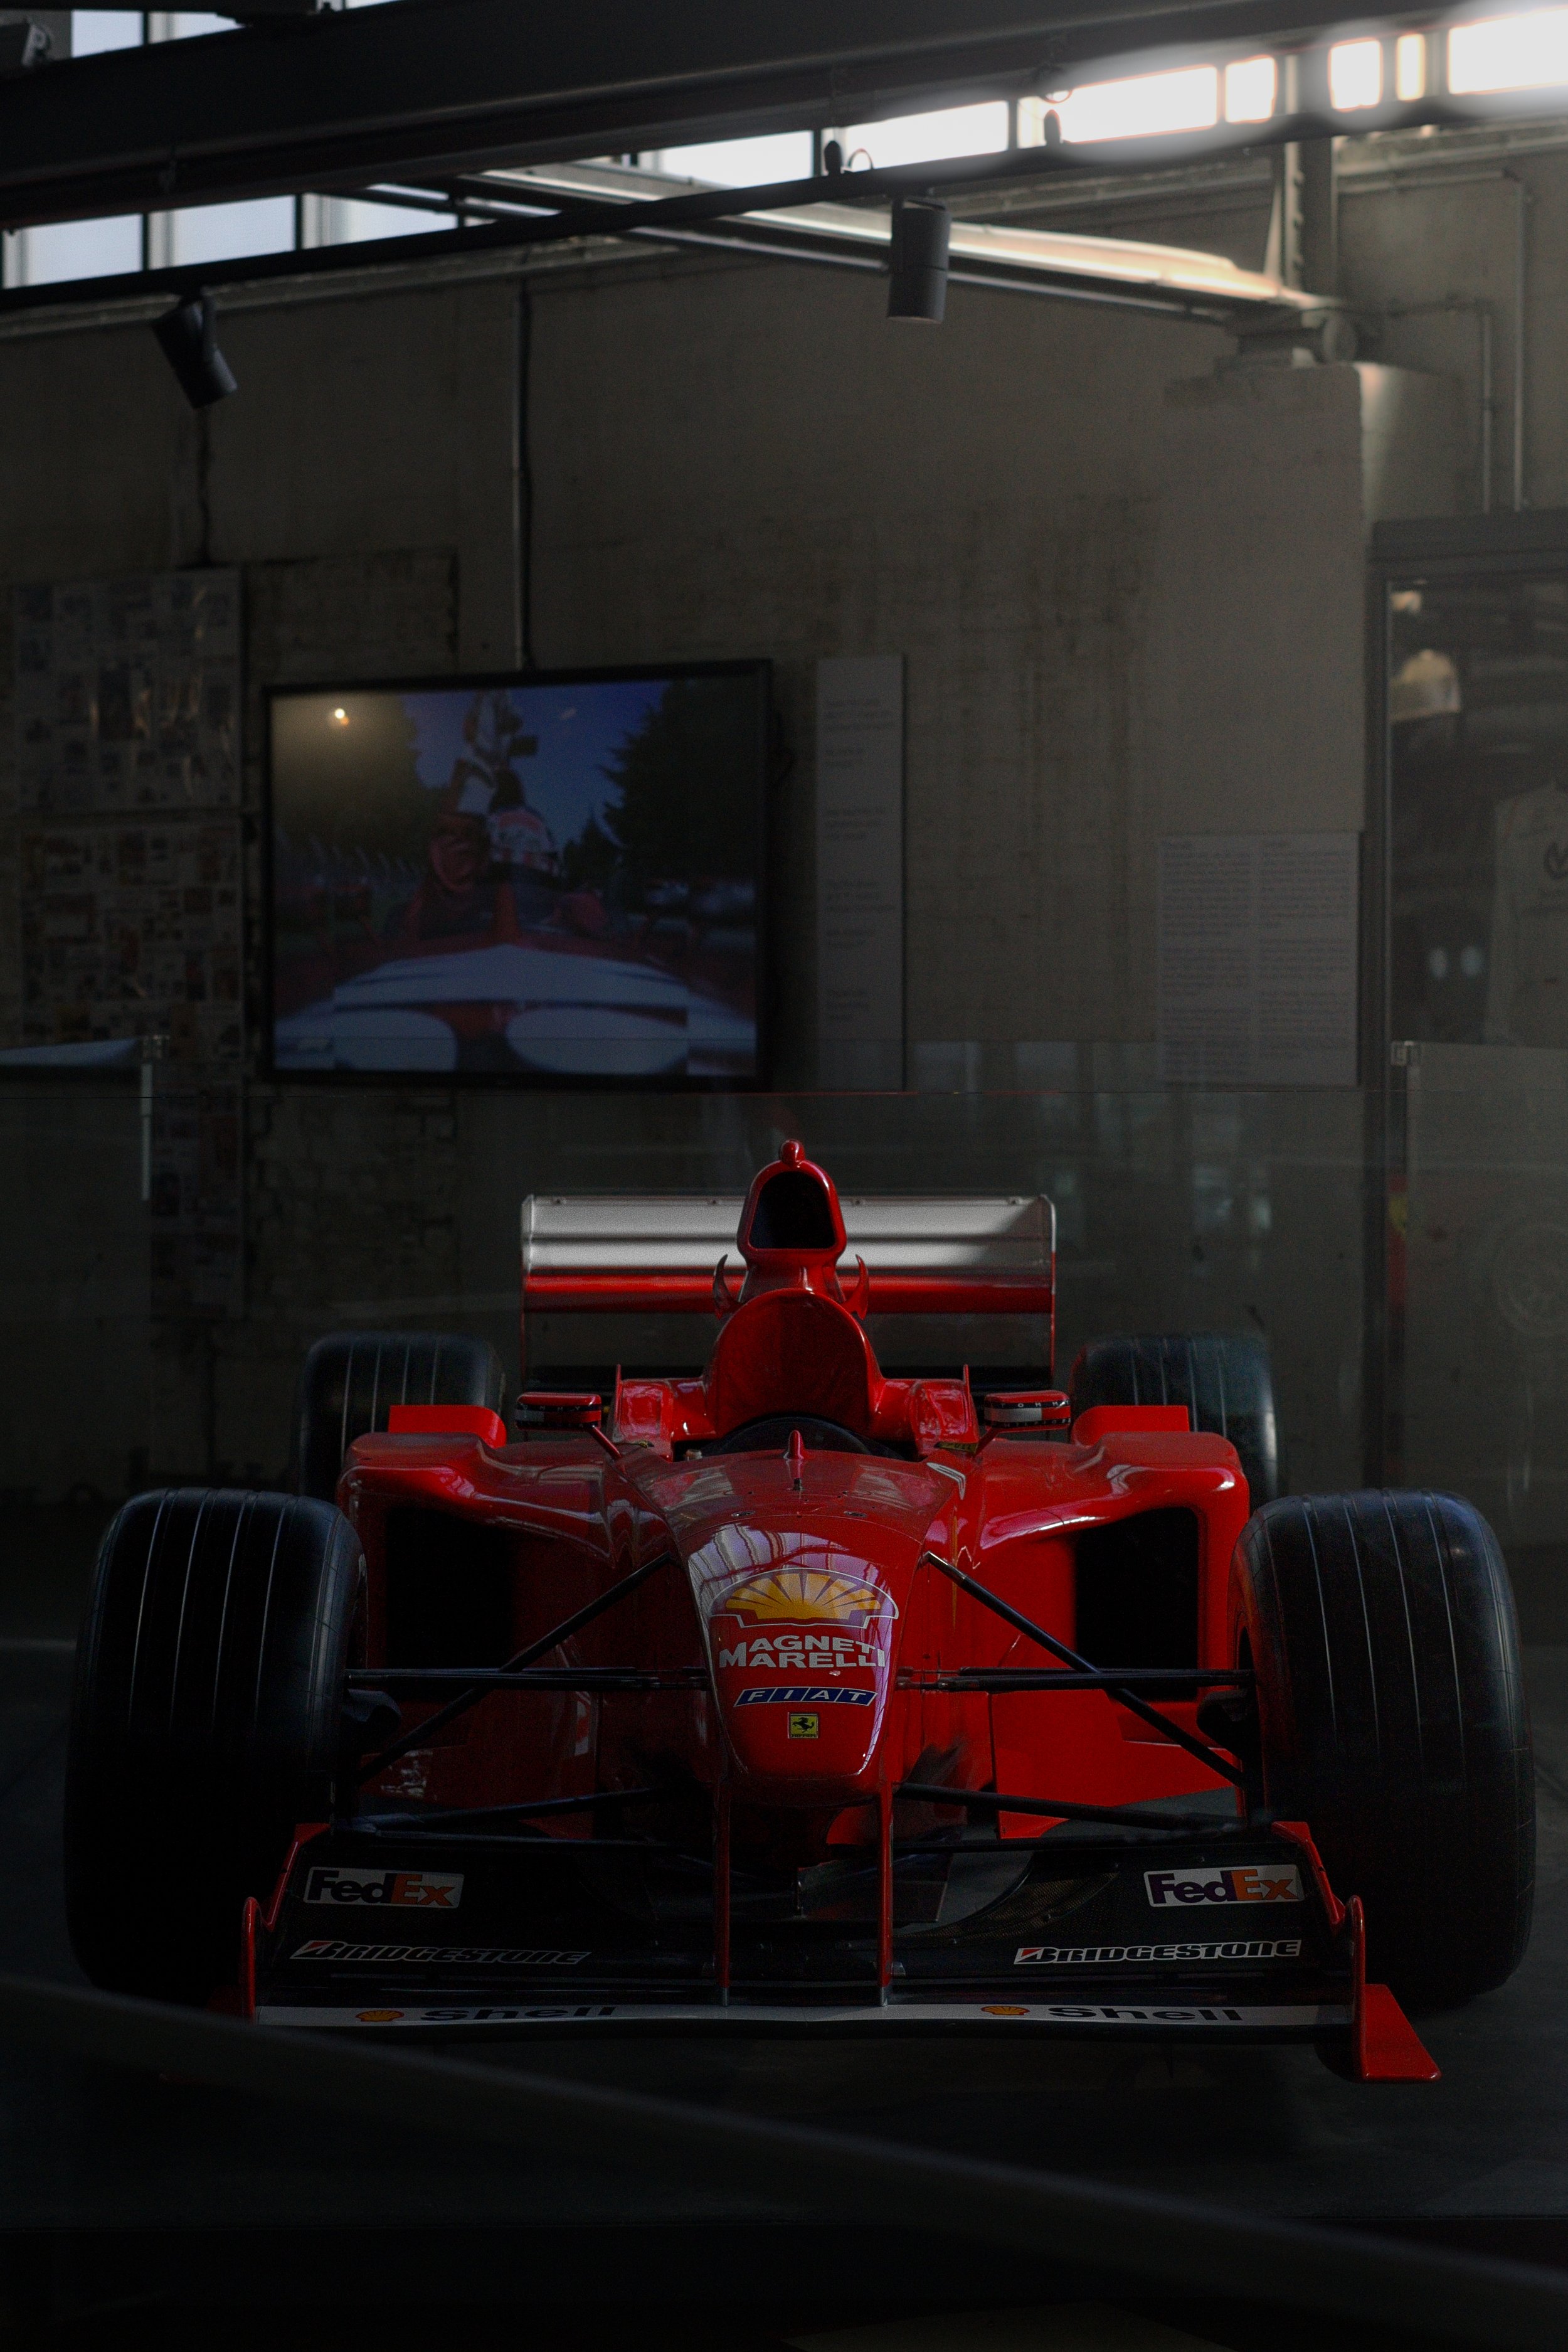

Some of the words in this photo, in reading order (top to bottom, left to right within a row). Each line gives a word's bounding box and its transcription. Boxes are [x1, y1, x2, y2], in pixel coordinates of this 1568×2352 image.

[719, 1642, 885, 1668] MARELLI
[746, 1689, 867, 1702] FIAT
[307, 1870, 455, 1907] FedEx
[1147, 1869, 1298, 1904] FedEx
[289, 1940, 593, 1965] BRIDGESTONE
[1014, 1939, 1302, 1964] BRIDGESTONE
[420, 2007, 617, 2021] Shell
[1047, 2007, 1242, 2021] Shell
